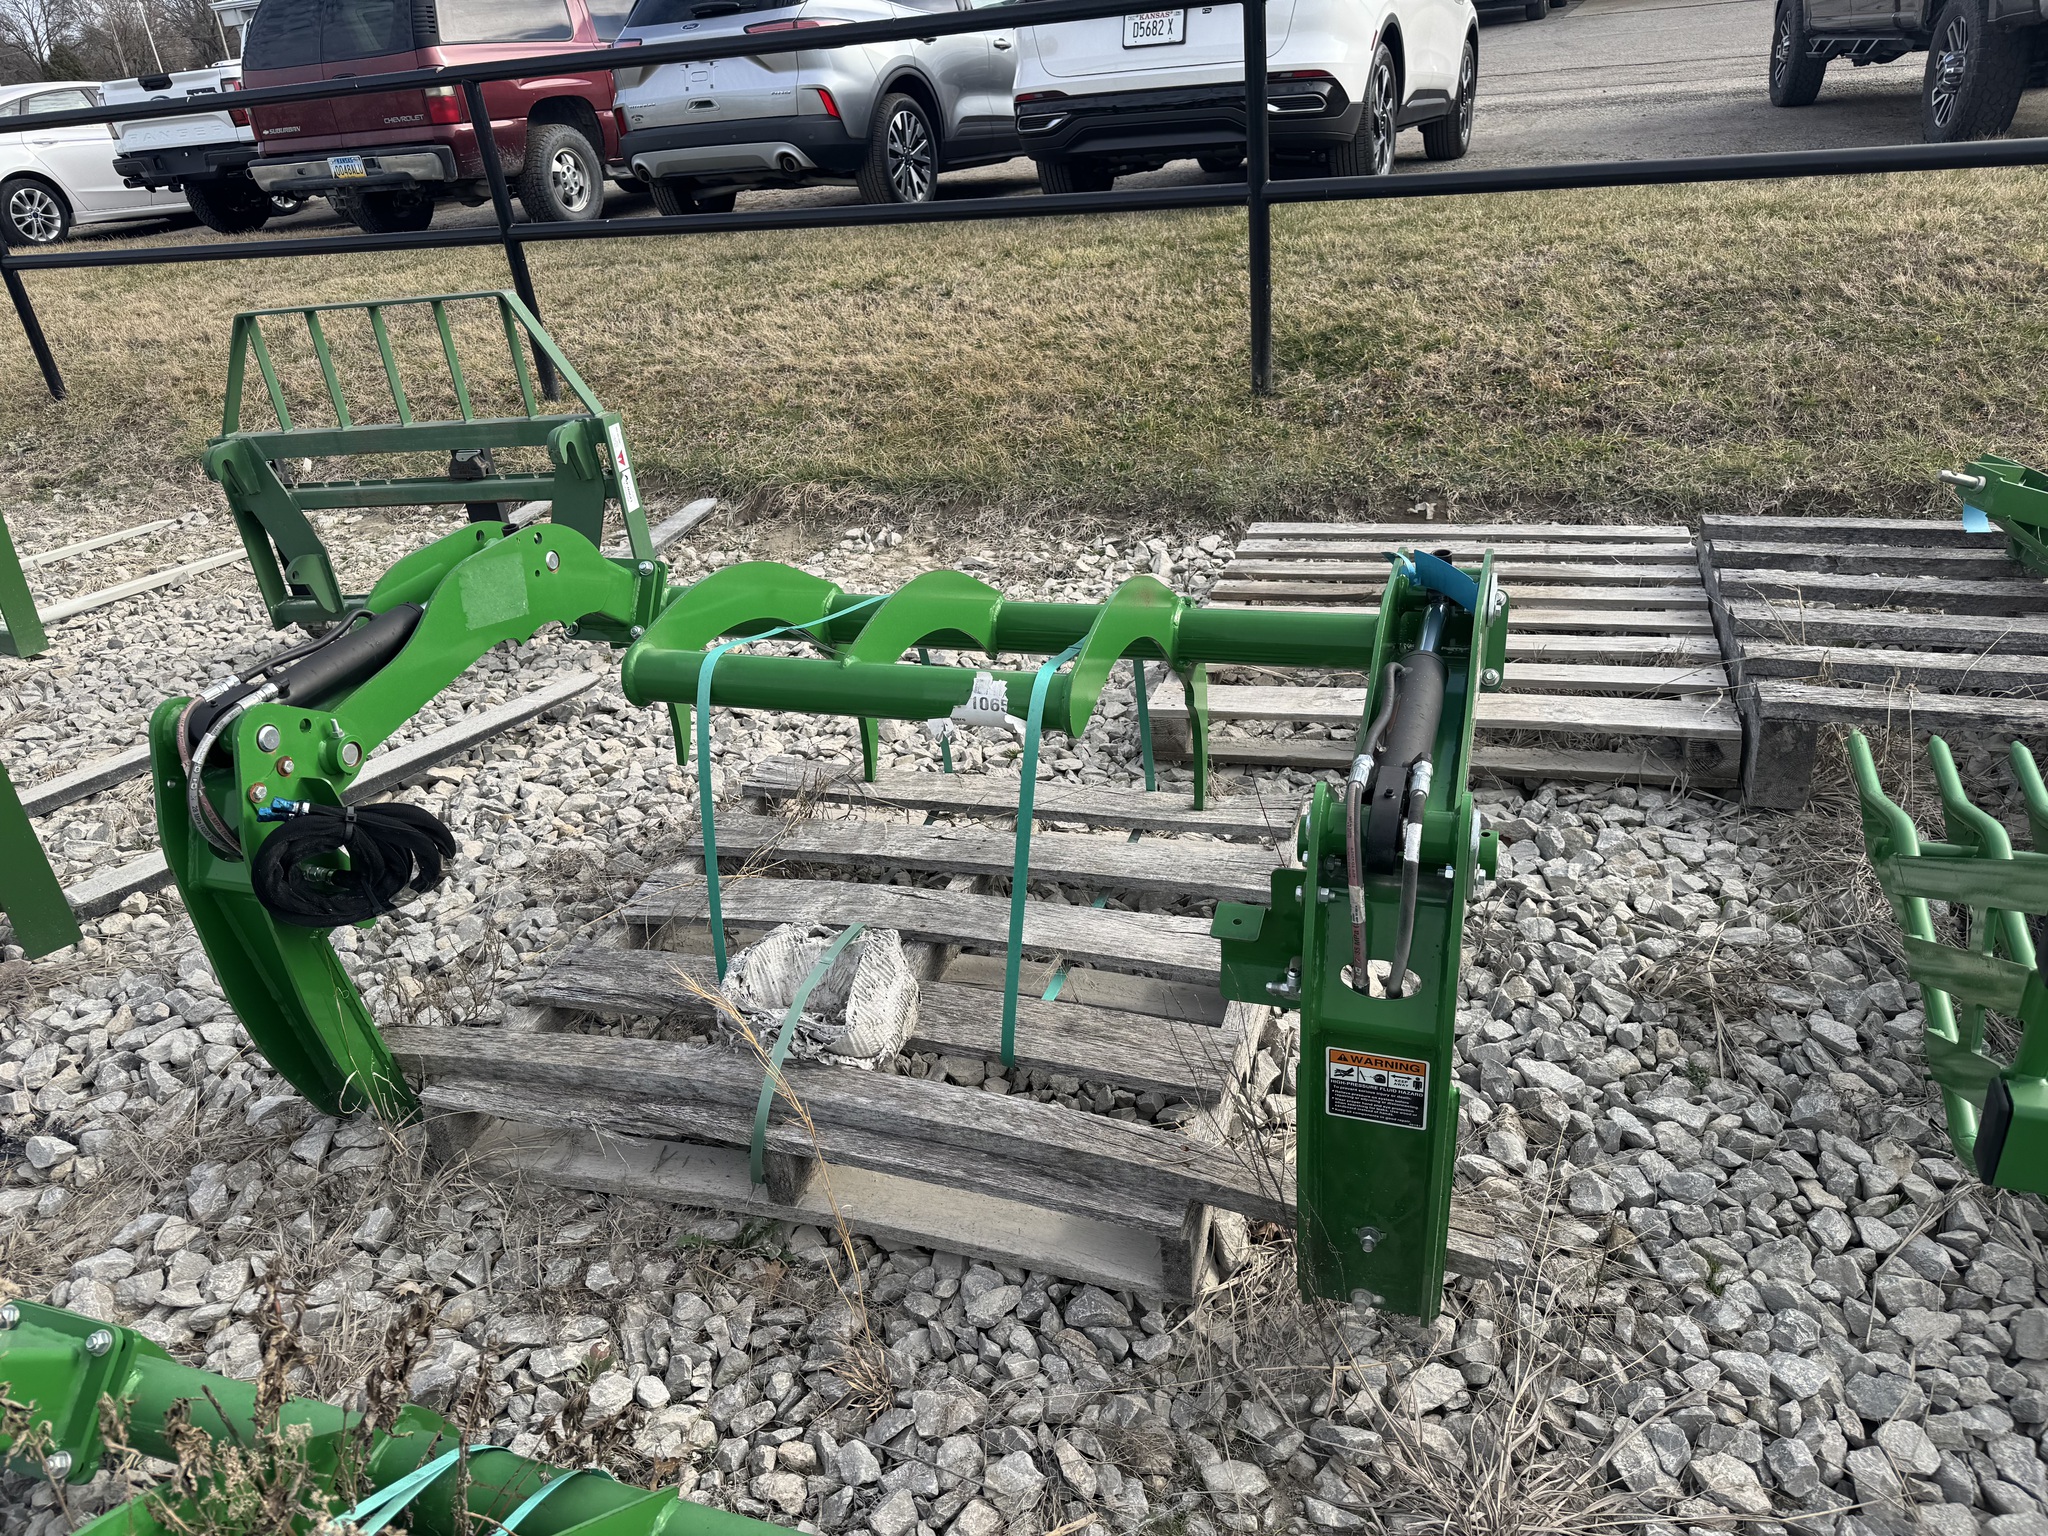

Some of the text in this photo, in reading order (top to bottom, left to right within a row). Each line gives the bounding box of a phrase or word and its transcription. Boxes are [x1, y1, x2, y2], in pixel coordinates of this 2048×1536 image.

[1139, 11, 1171, 20] KANSAS
[1133, 18, 1174, 38] D5682 X
[384, 113, 424, 124] CHEVROLET
[127, 124, 224, 143] RANGER
[269, 125, 301, 135] SUBURBAN
[1350, 1054, 1421, 1073] WARNING
[1330, 1079, 1378, 1091] HIGH-PRESSURE
